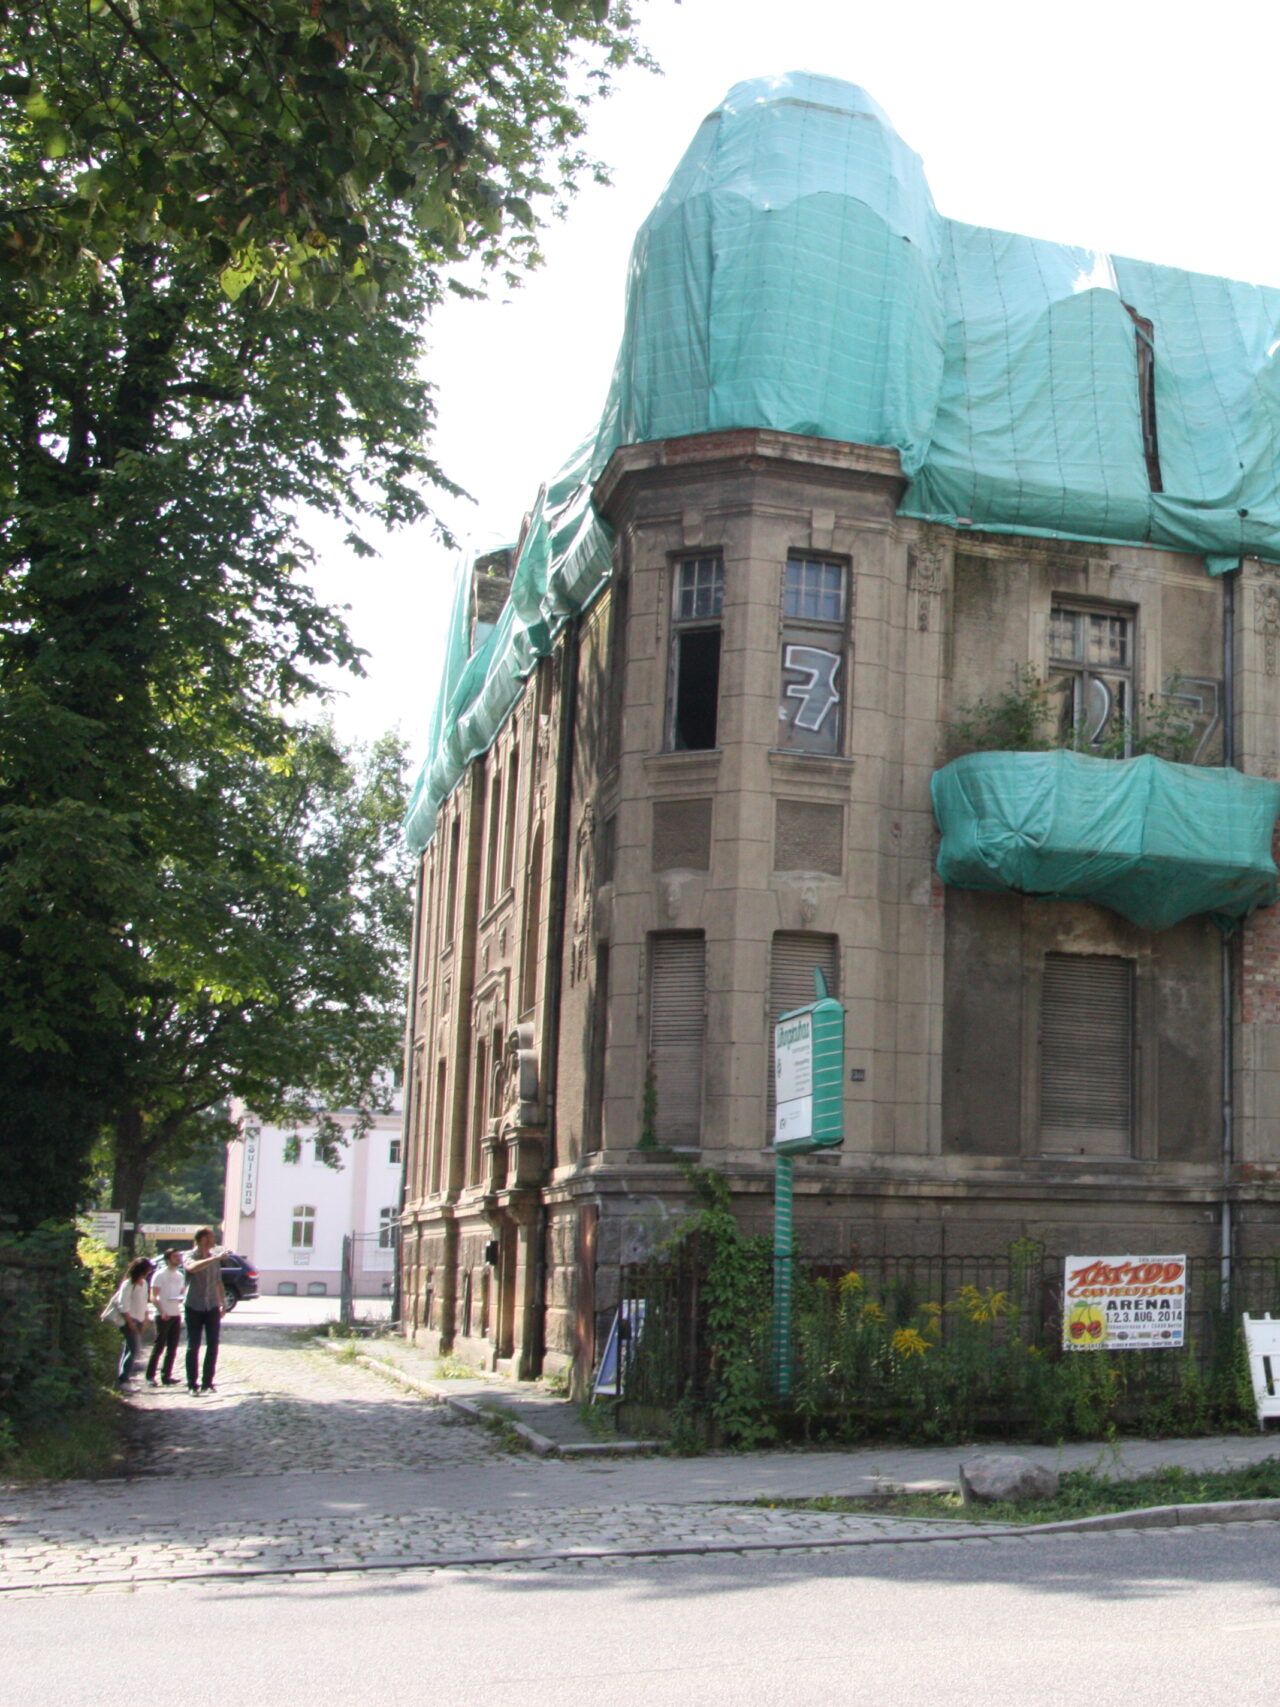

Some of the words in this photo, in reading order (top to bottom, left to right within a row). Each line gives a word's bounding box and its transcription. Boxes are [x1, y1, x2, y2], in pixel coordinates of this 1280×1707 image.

[1106, 1299, 1171, 1311] ARENA
[1134, 1311, 1155, 1321] AUG.
[1158, 1311, 1182, 1321] 2014
